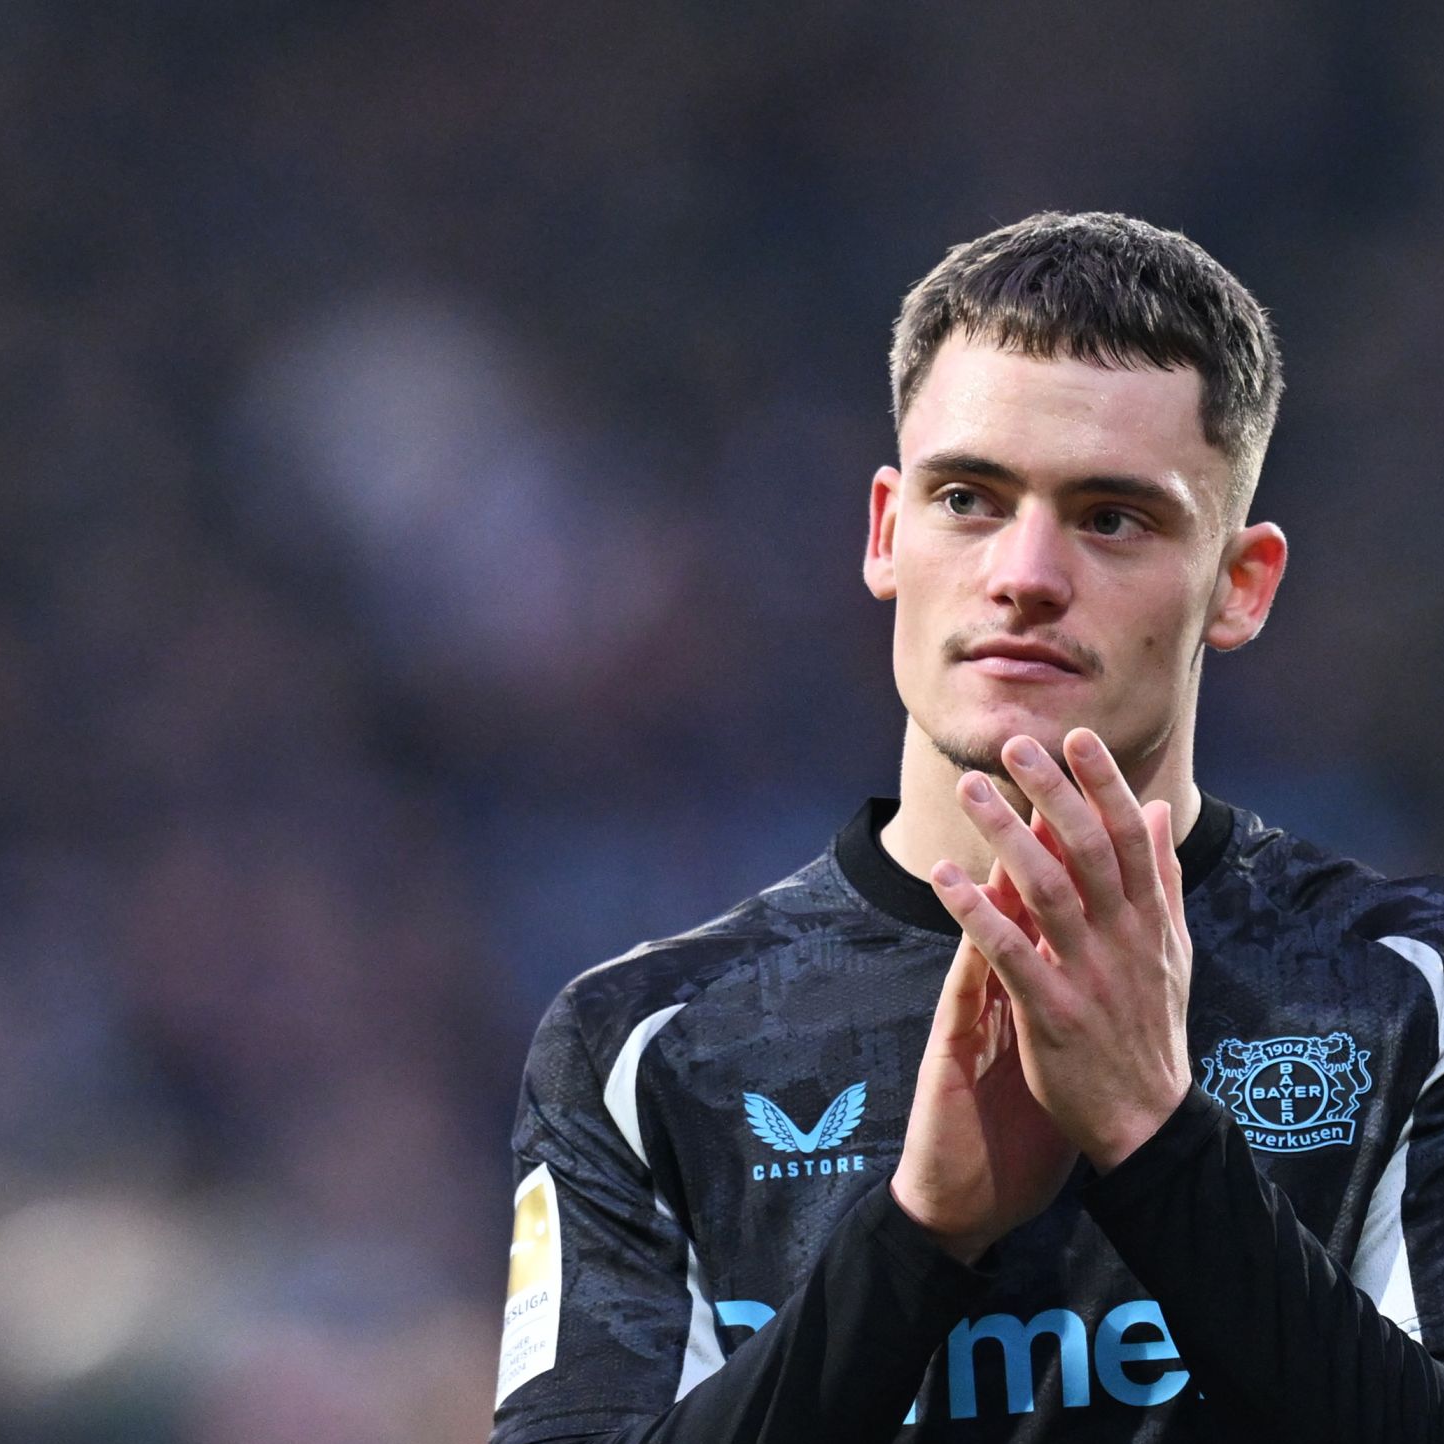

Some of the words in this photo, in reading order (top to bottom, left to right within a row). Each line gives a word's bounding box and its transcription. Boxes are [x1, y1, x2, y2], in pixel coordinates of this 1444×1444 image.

[1264, 1043, 1304, 1058] 1904
[1252, 1085, 1322, 1100] BAYER
[1279, 1062, 1295, 1124] BAYER
[1245, 1127, 1344, 1148] everkusen
[753, 1156, 864, 1181] CASTORE
[504, 1291, 548, 1325] ESLIGA
